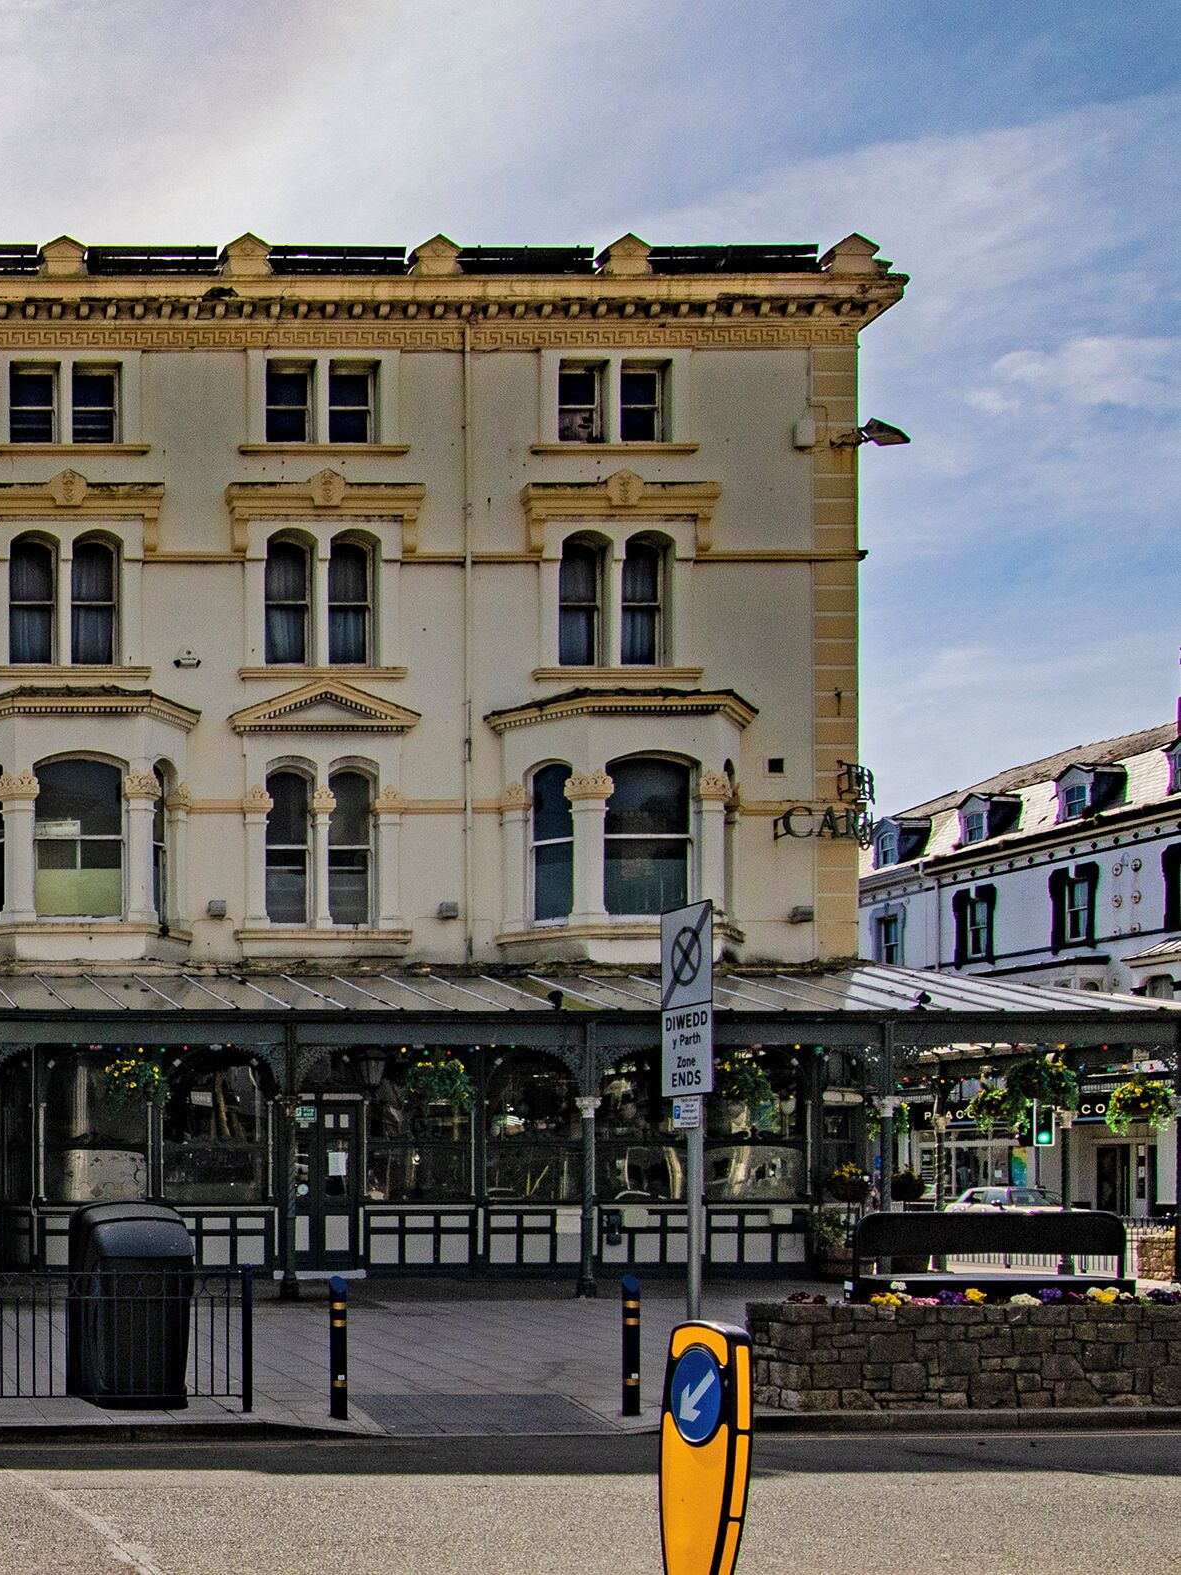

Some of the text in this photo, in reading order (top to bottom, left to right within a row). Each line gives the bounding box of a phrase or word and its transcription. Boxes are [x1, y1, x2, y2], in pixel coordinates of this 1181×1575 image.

[665, 1010, 708, 1032] DIWEDD
[672, 1032, 701, 1050] y Parth
[677, 1056, 696, 1068] Zone
[671, 1070, 701, 1088] ENDS
